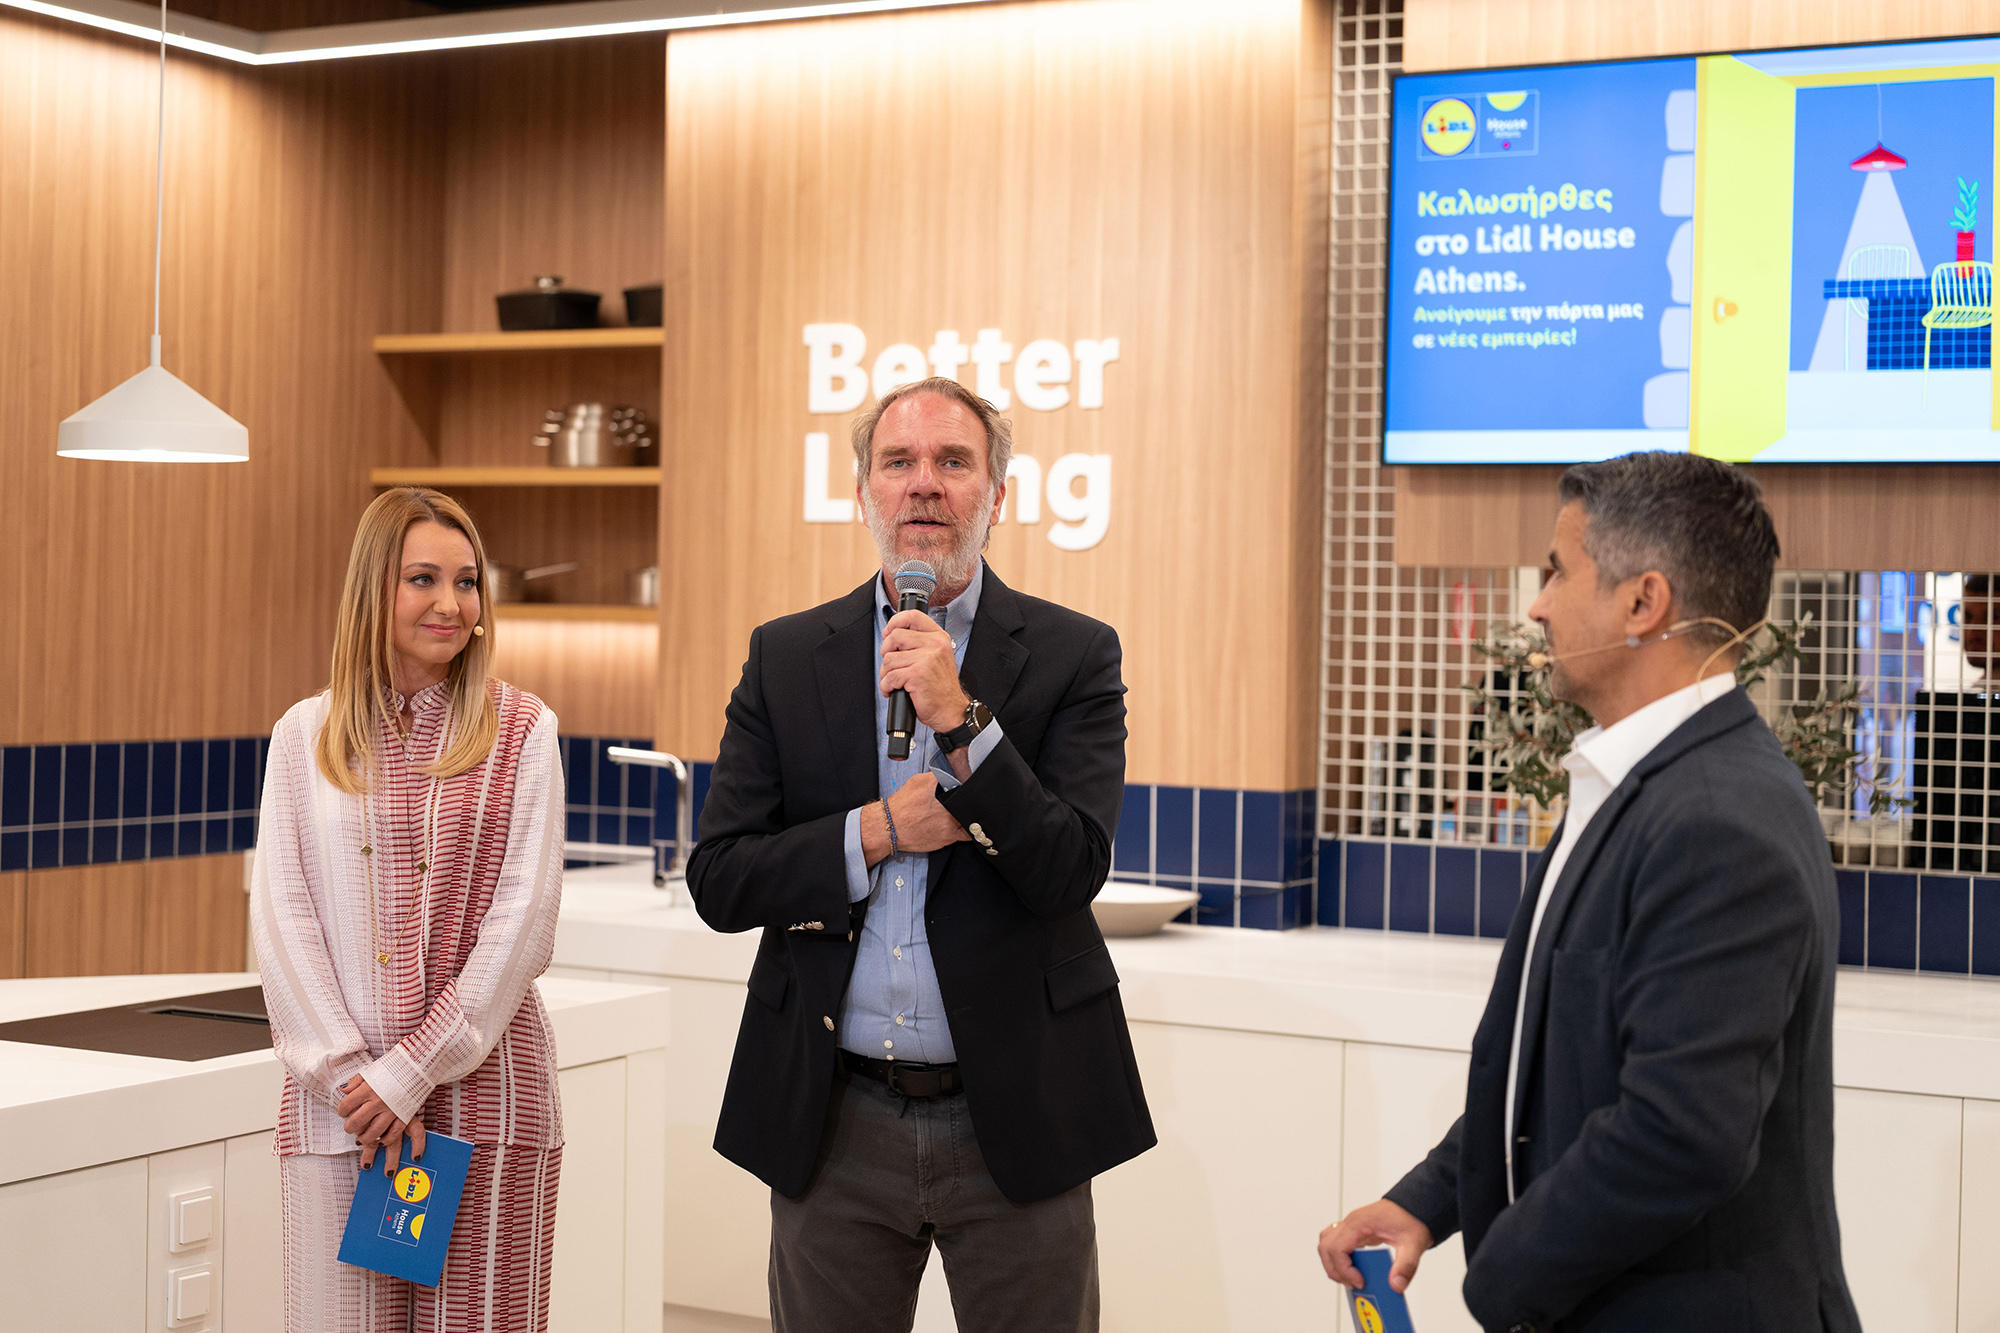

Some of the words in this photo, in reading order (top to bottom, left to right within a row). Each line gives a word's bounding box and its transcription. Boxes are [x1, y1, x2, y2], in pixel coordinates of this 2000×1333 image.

[1486, 118, 1528, 132] House
[1417, 183, 1614, 219] Καλωσήρθες
[1415, 233, 1470, 256] στο
[1476, 224, 1533, 254] Lidl
[1539, 223, 1637, 251] House
[1414, 265, 1527, 294] Athens.
[1413, 305, 1508, 326] Ανοίγουμε
[1510, 305, 1543, 324] την
[1546, 301, 1605, 323] πόρτα
[1607, 302, 1645, 322] μας
[1412, 333, 1436, 349] σε
[1438, 330, 1479, 349] νέες
[1481, 327, 1578, 350] εμπειρίες!
[802, 323, 1120, 413] Better
[396, 1208, 410, 1235] House
